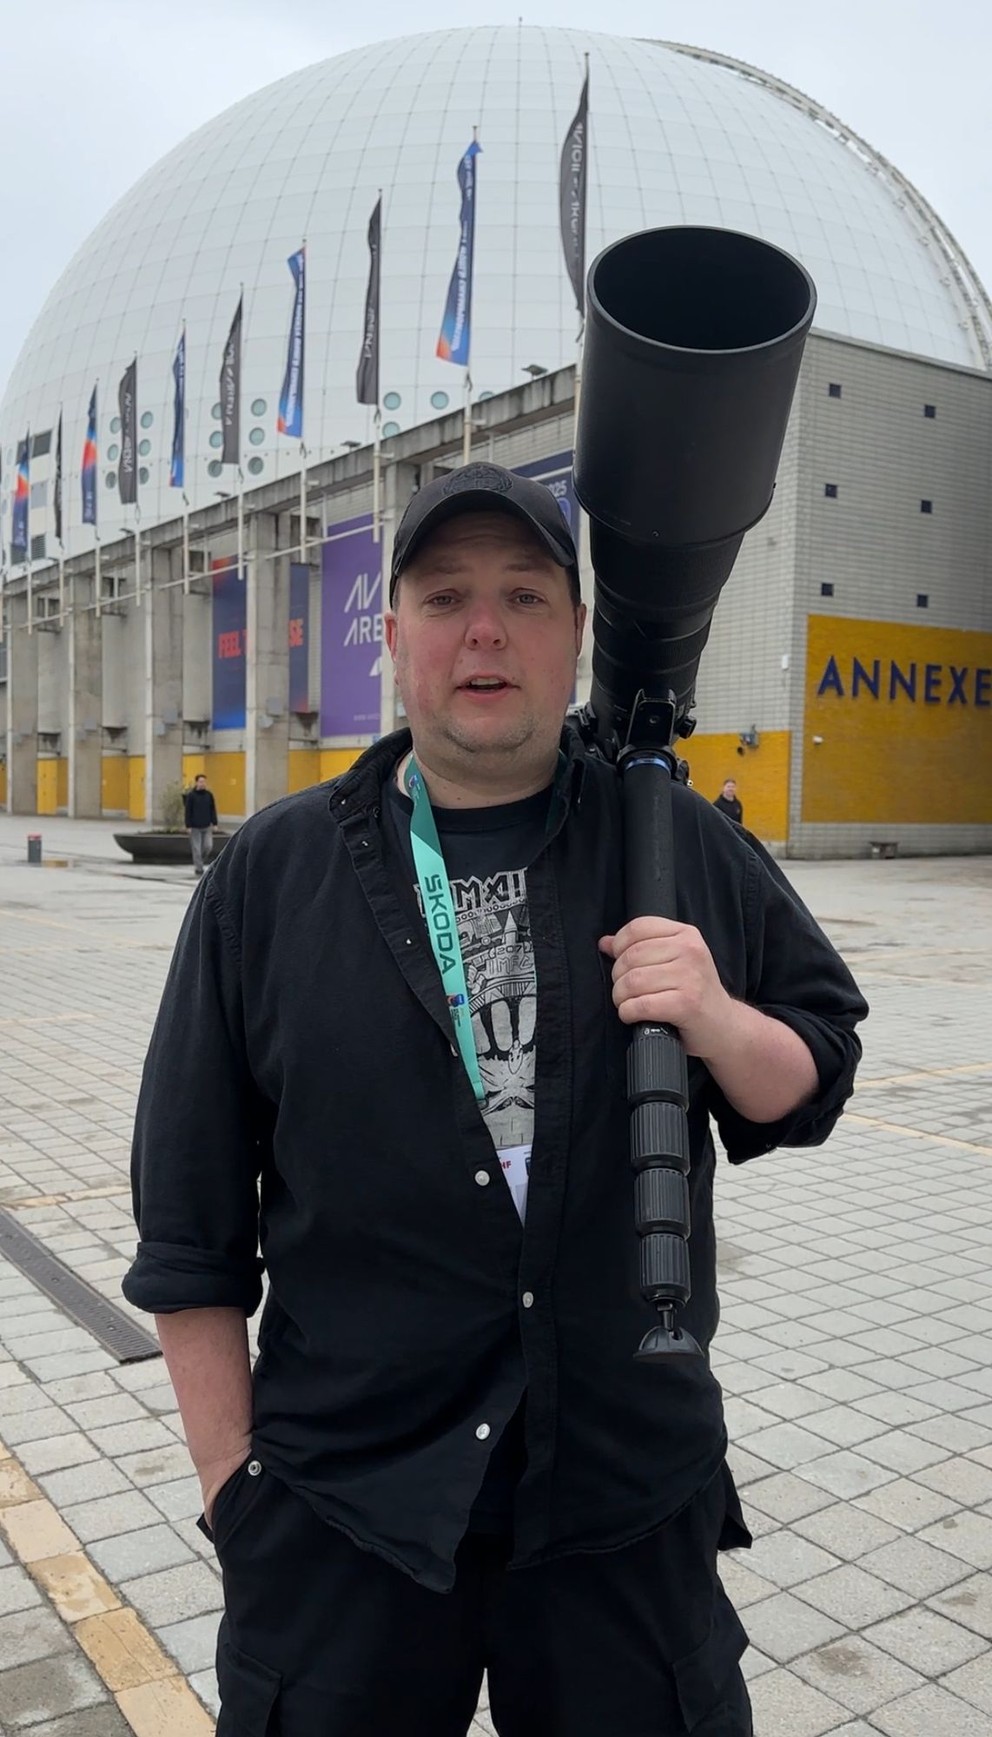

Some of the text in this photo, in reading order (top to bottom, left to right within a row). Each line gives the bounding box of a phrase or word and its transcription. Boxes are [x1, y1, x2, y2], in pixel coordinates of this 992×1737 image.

[343, 572, 382, 613] AV
[217, 630, 241, 659] FEEL
[343, 613, 383, 647] ARE
